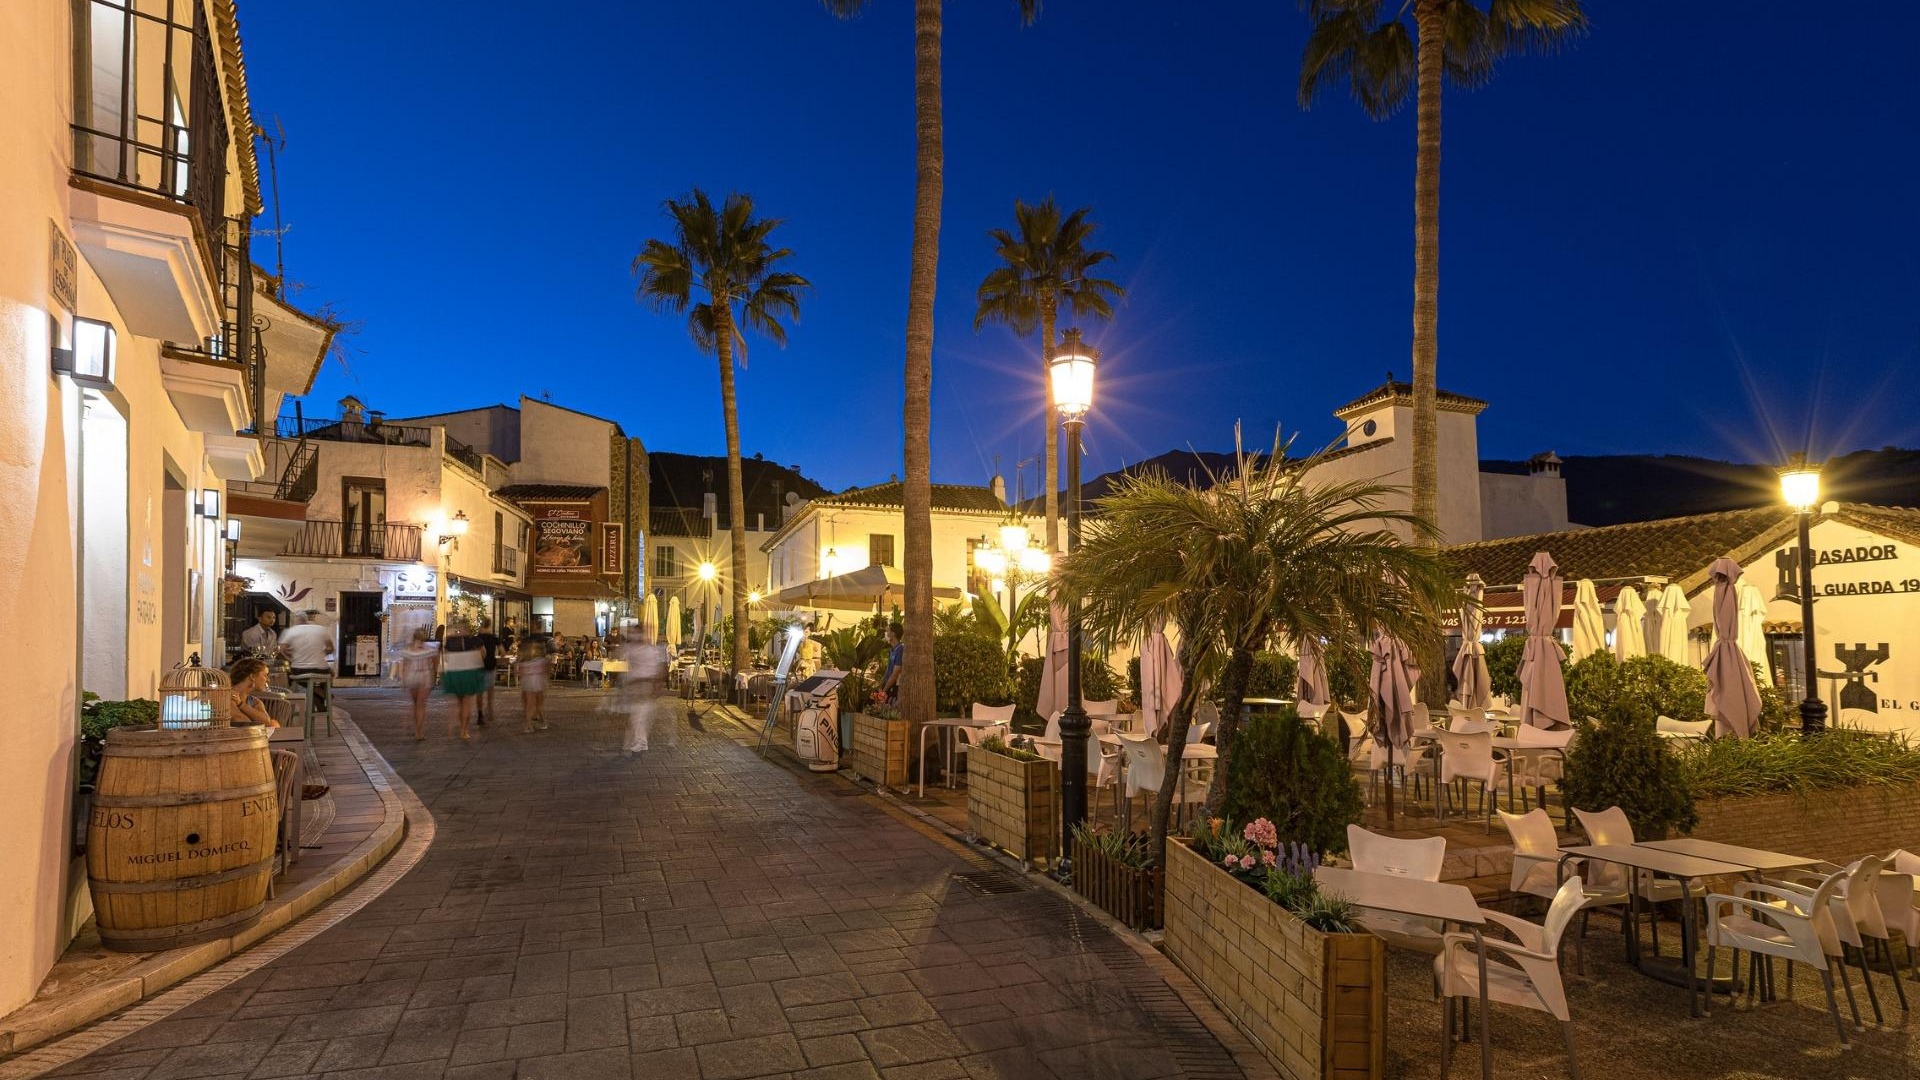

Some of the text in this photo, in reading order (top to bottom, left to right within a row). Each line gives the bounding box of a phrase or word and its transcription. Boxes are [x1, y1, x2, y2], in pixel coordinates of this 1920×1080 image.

[541, 521, 585, 529] COCHINILLO
[609, 530, 617, 567] PIZZERIA
[1819, 544, 1898, 564] ASADOR
[1824, 580, 1895, 596] GUARDA
[1881, 699, 1902, 710] EL
[820, 718, 840, 748] PING
[128, 840, 255, 865] MIGUEL DOMECQ
